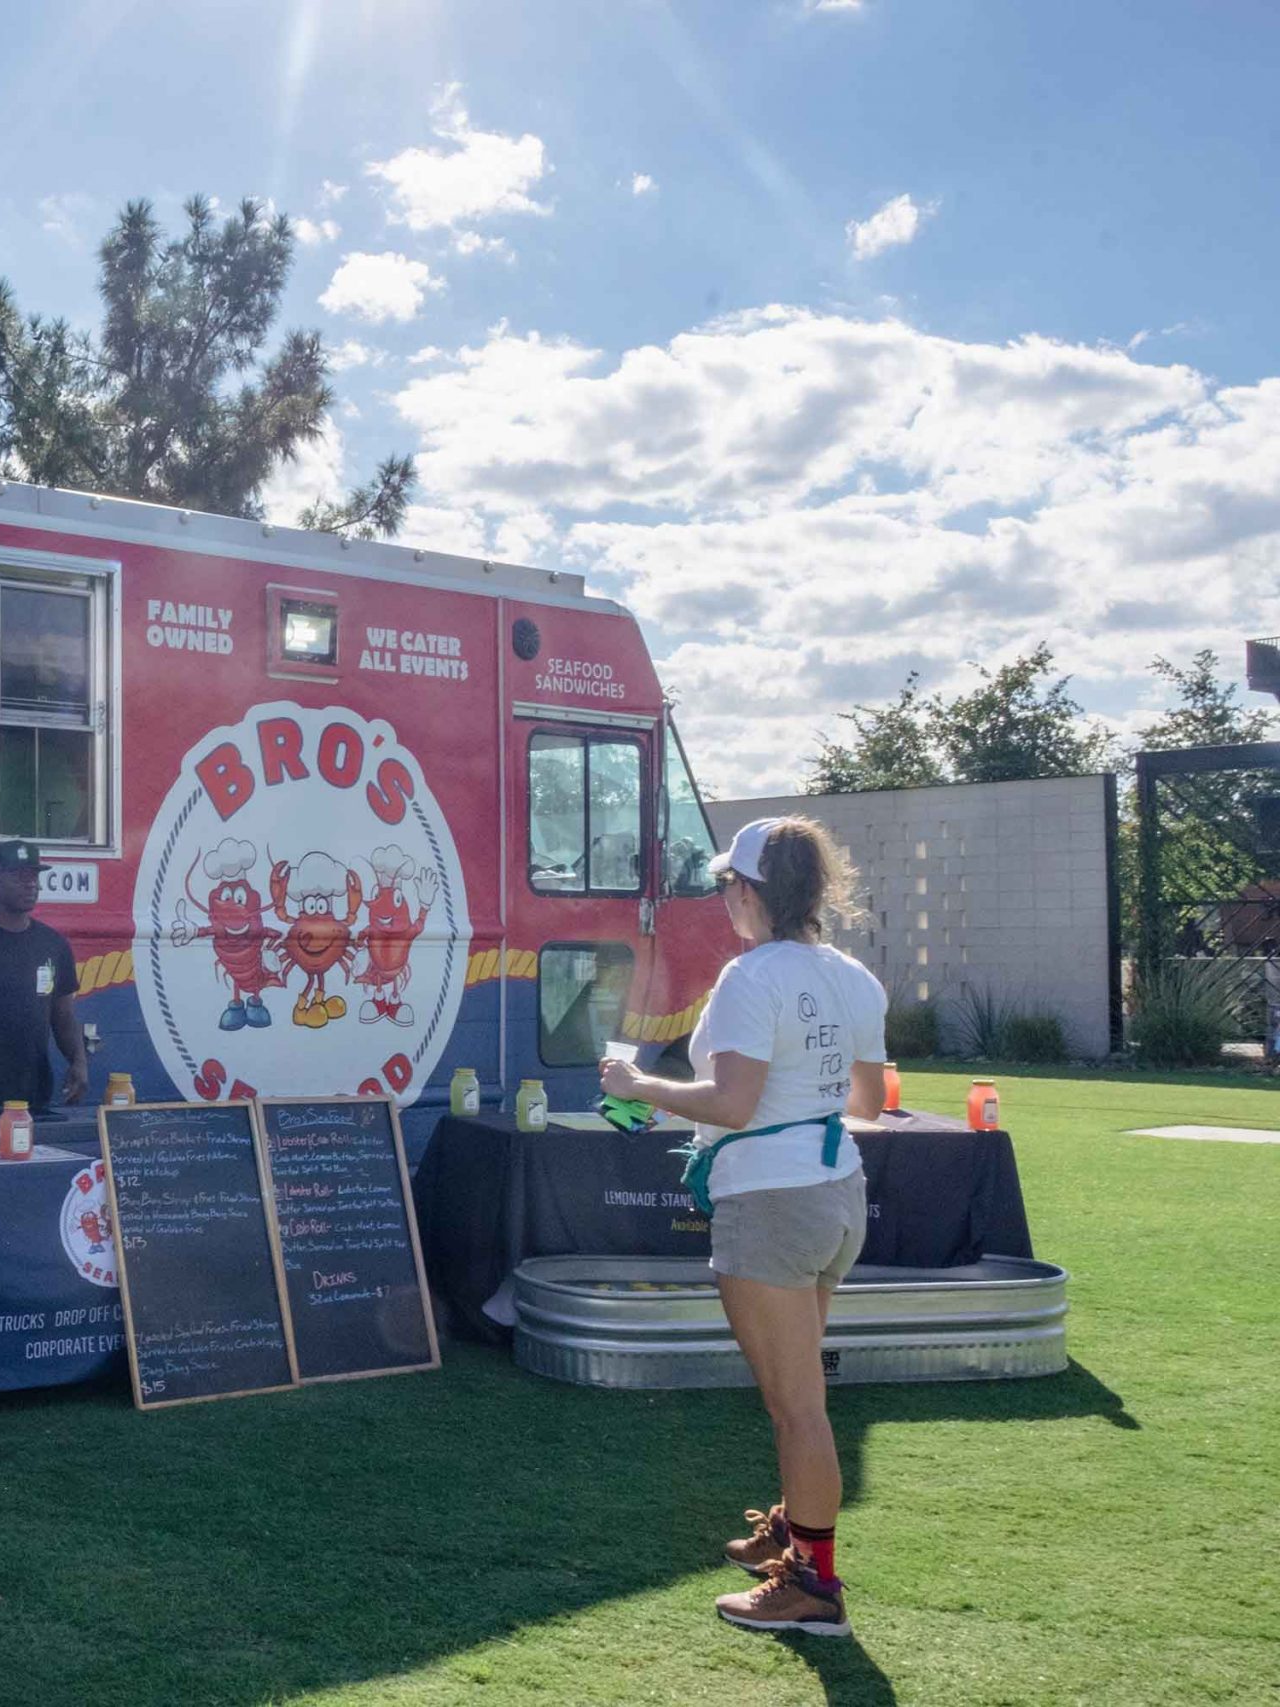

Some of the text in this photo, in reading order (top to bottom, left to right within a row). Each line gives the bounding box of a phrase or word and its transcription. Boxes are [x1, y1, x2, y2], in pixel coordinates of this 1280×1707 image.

[147, 599, 232, 630] FAMILY
[147, 625, 233, 655] OWNED
[366, 627, 461, 657] WE CATER
[359, 650, 468, 681] ALL EVENTS
[548, 658, 613, 680] SEAFOOD
[535, 674, 625, 699] SANDWICHES
[195, 716, 415, 826] BRO'S
[604, 1191, 657, 1206] LEMONADE
[0, 1313, 45, 1332] TRUCKS
[55, 1309, 87, 1327] DROP
[89, 1306, 111, 1323] OFF
[26, 1337, 95, 1359] CORPORATE
[140, 1380, 166, 1395] $15
